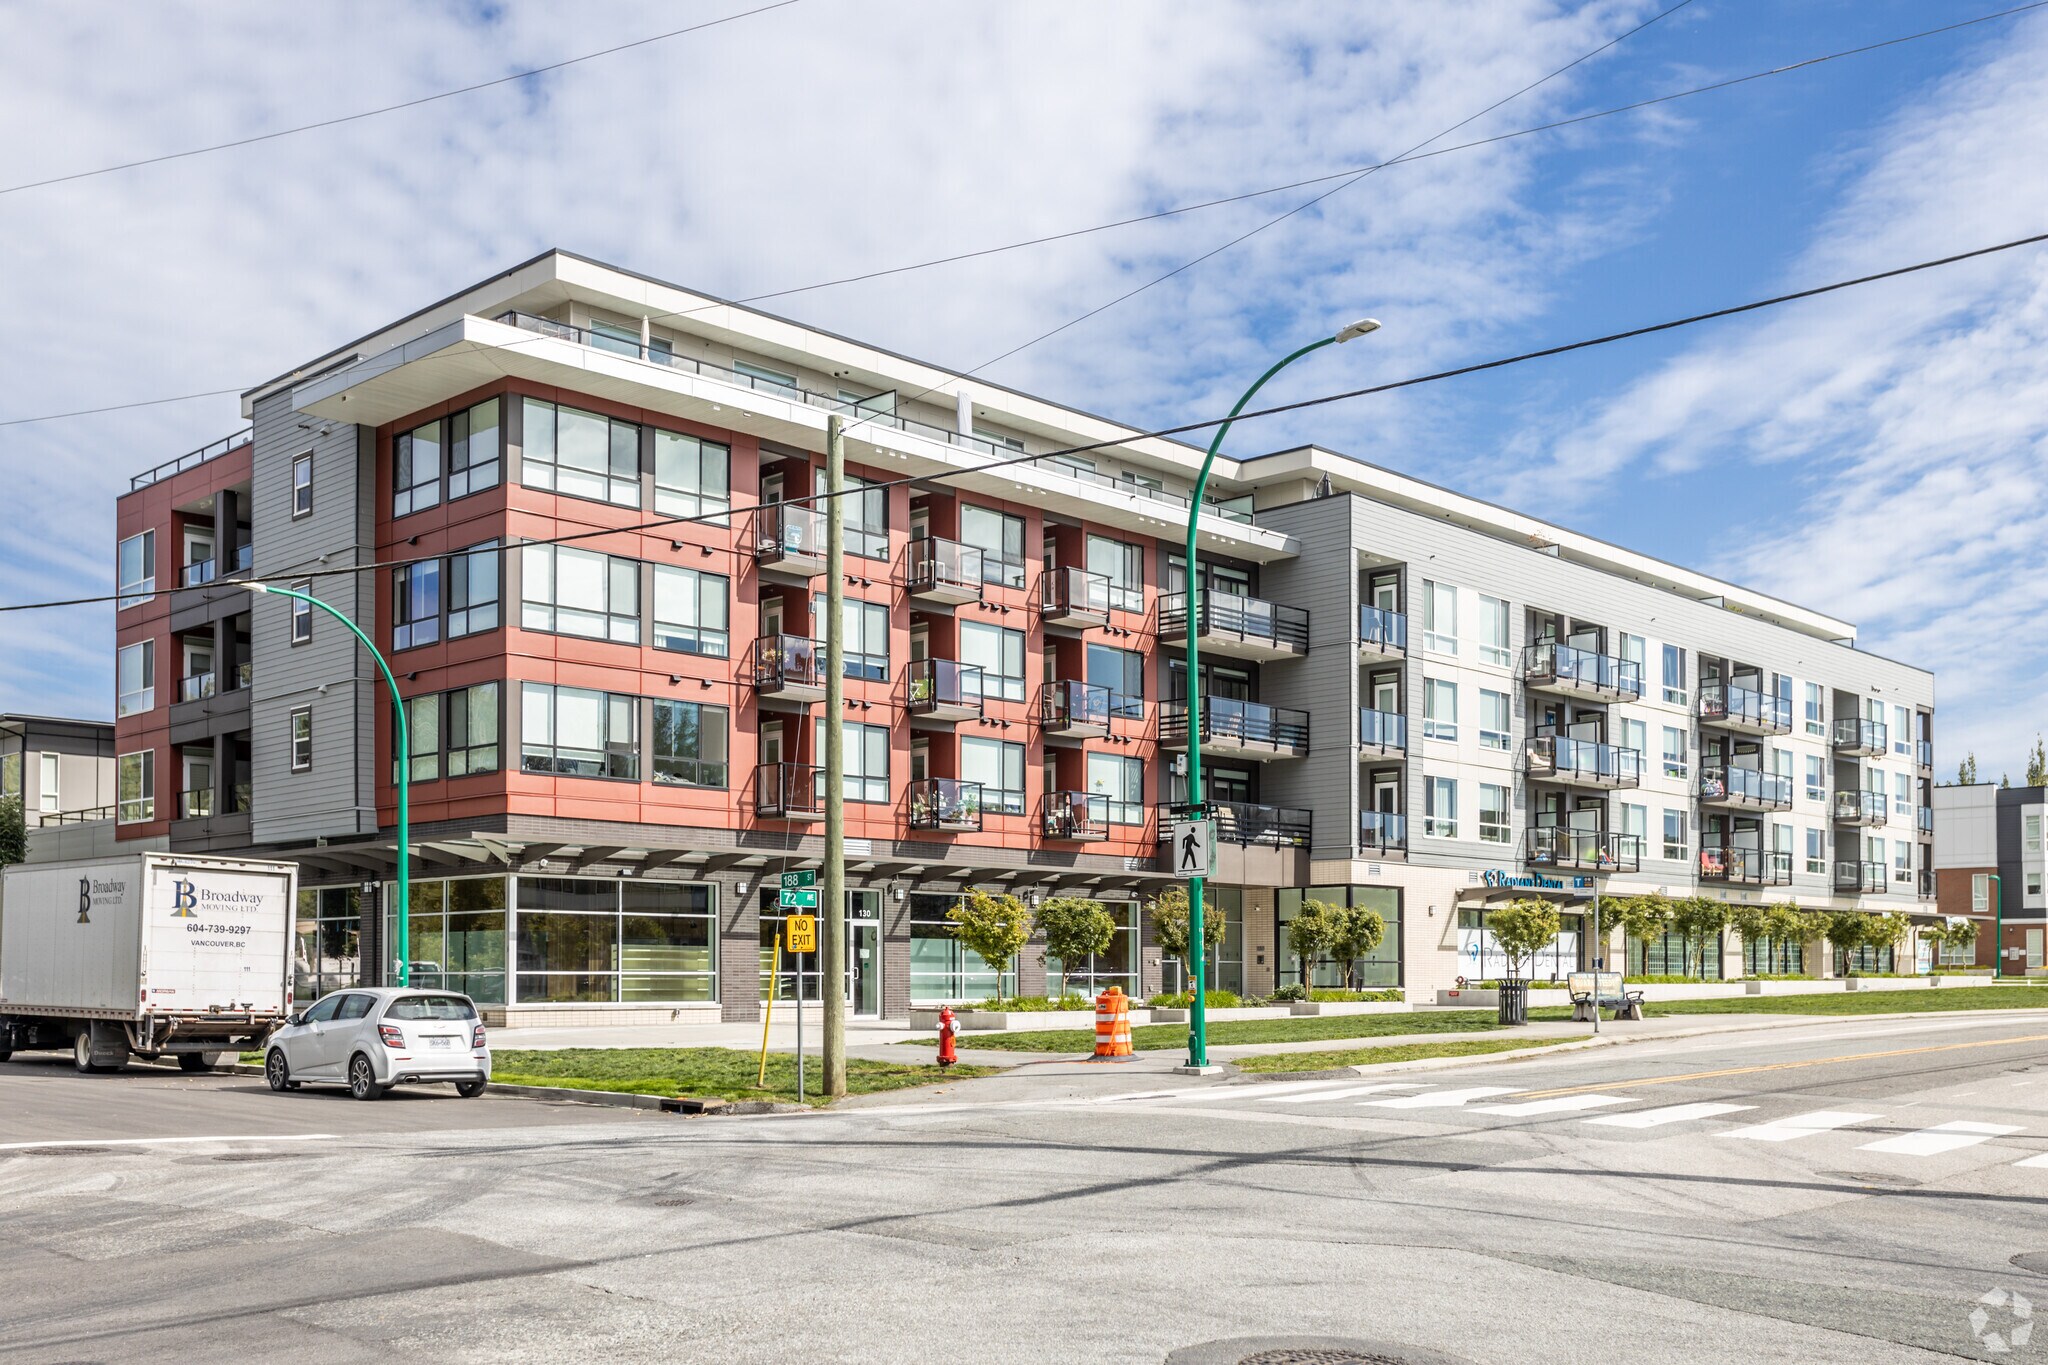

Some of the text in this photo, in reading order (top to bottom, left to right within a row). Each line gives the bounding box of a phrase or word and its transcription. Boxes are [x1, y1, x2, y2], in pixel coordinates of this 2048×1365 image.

[784, 873, 813, 887] 188 ST
[1498, 870, 1535, 887] RADIANT
[92, 877, 126, 896] Broadway
[92, 896, 112, 906] MOVING
[201, 888, 264, 907] Broadway
[784, 893, 796, 904] 72
[201, 903, 259, 913] MOVING LTD.
[859, 910, 871, 918] 130
[186, 923, 251, 935] 604-739-9297
[795, 920, 808, 931] NO
[792, 934, 811, 946] EXIT
